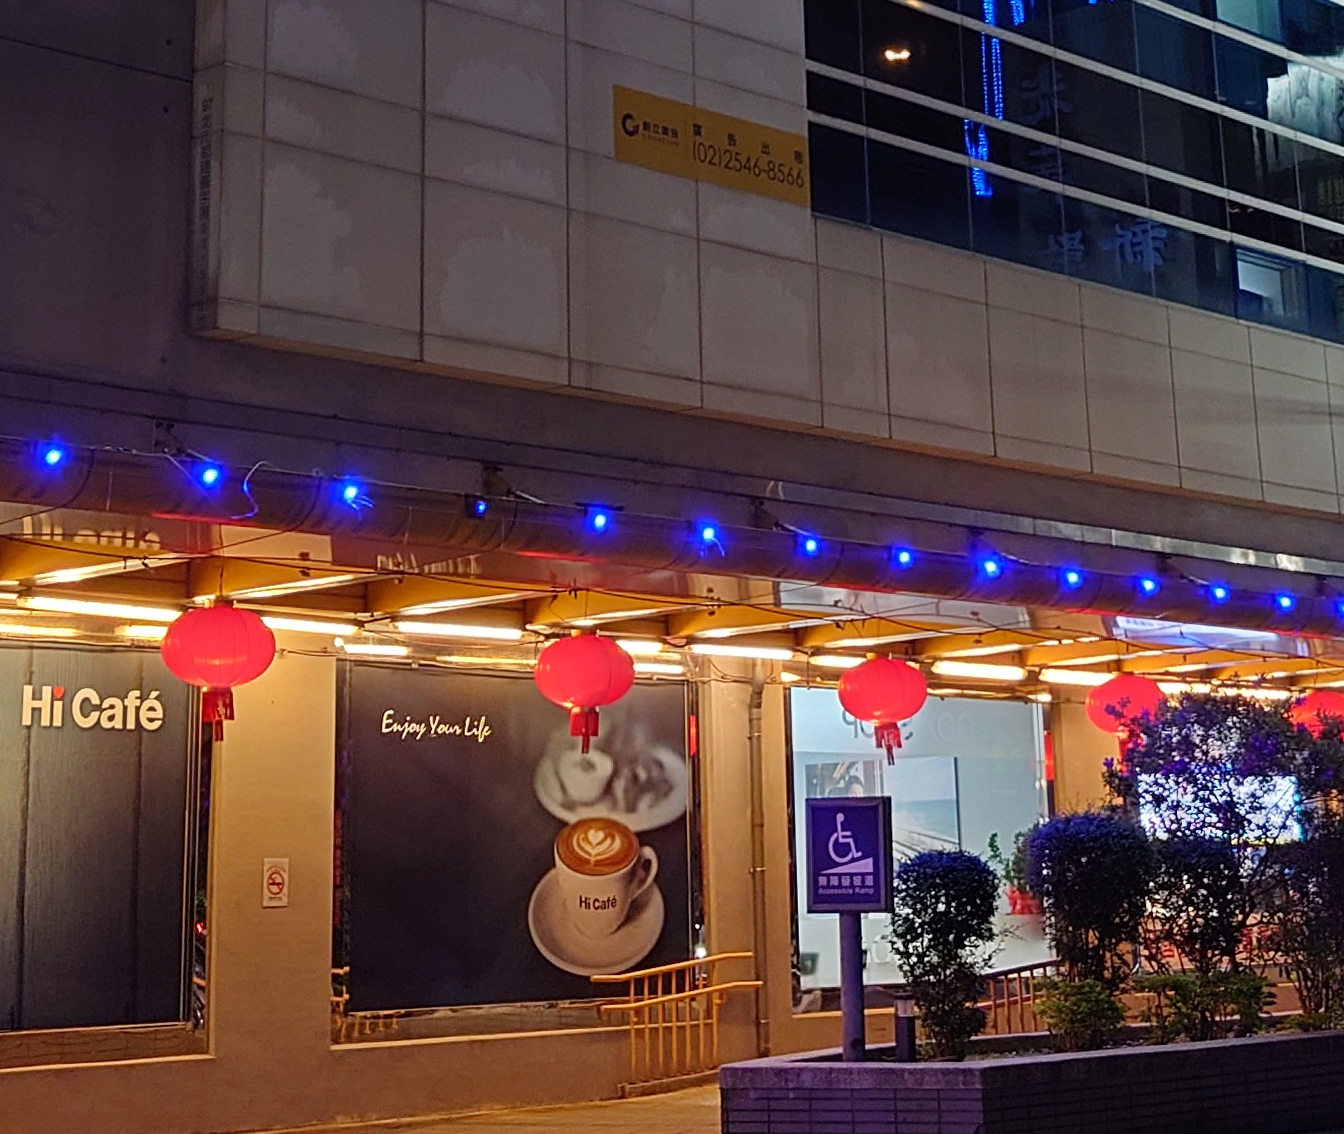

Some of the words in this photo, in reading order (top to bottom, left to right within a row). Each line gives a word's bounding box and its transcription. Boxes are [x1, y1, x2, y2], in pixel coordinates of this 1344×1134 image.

[21, 684, 65, 728] Hi
[71, 687, 164, 731] Café
[381, 709, 426, 741] Enjoy
[429, 715, 462, 735] Your
[464, 715, 492, 743] Life
[579, 894, 591, 910] Hi
[592, 894, 617, 911] Café
